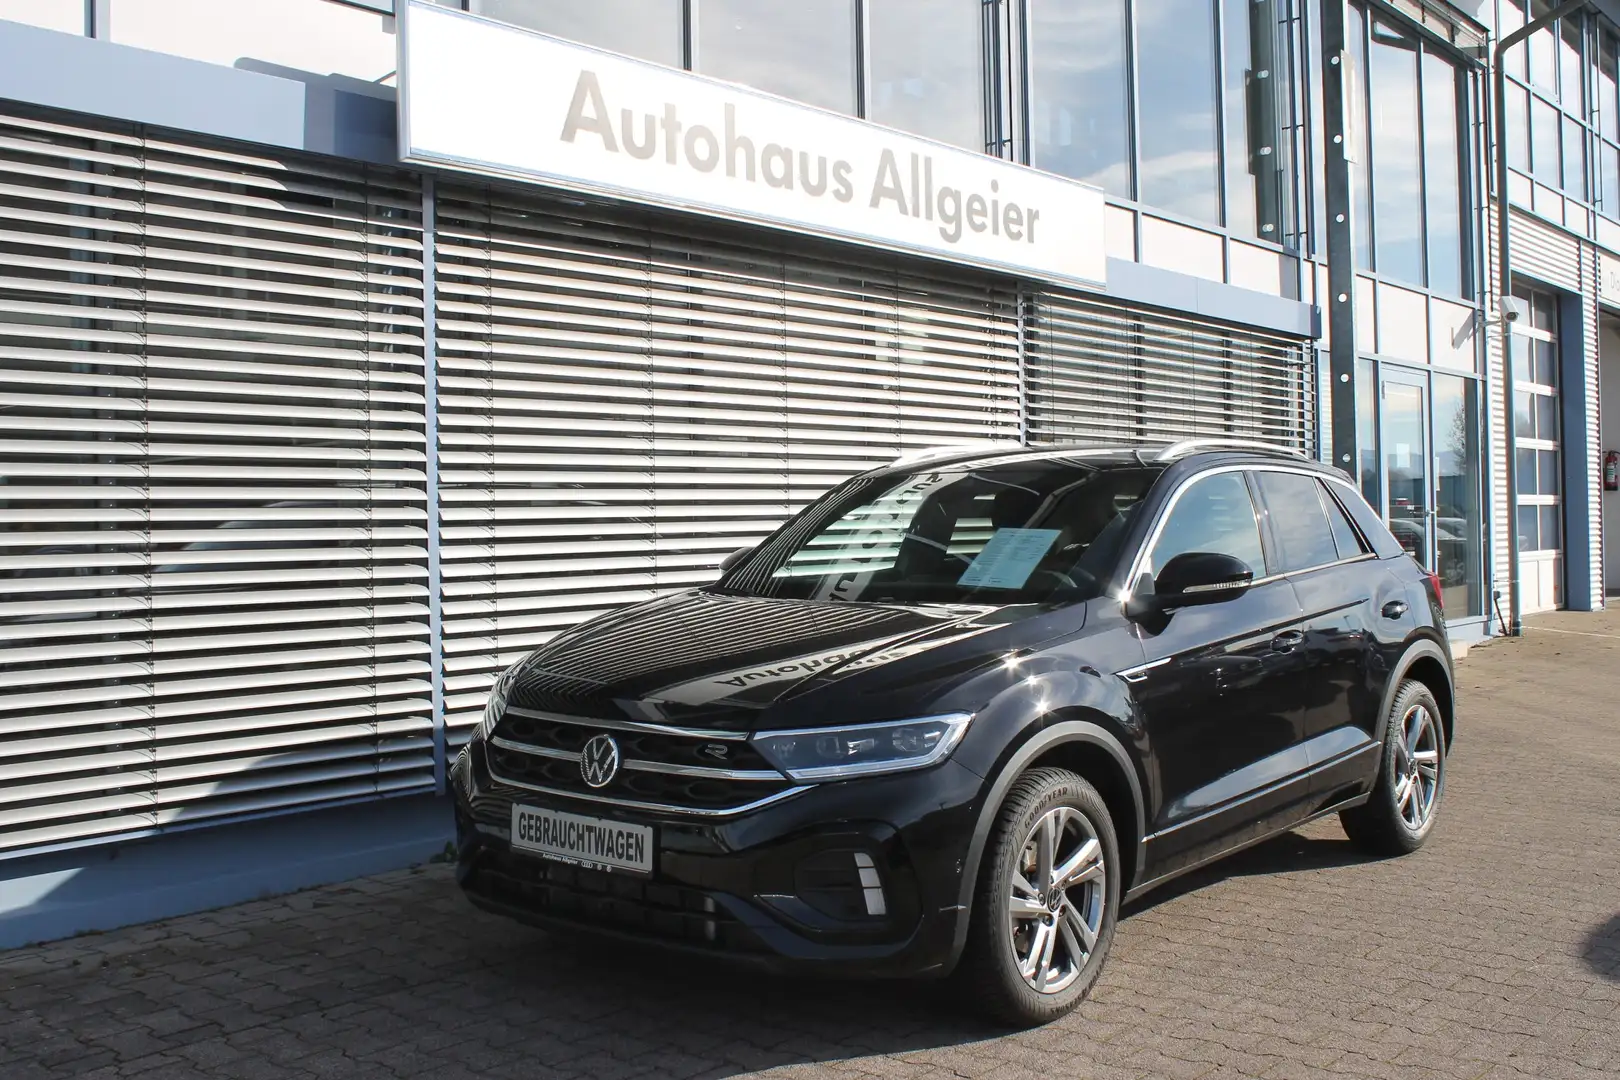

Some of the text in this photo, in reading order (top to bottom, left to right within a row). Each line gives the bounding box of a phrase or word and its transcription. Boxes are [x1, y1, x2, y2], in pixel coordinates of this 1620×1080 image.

[560, 69, 1040, 244] Autohaus Allgeier
[518, 812, 645, 863] GEBRAUCHTWAGEN
